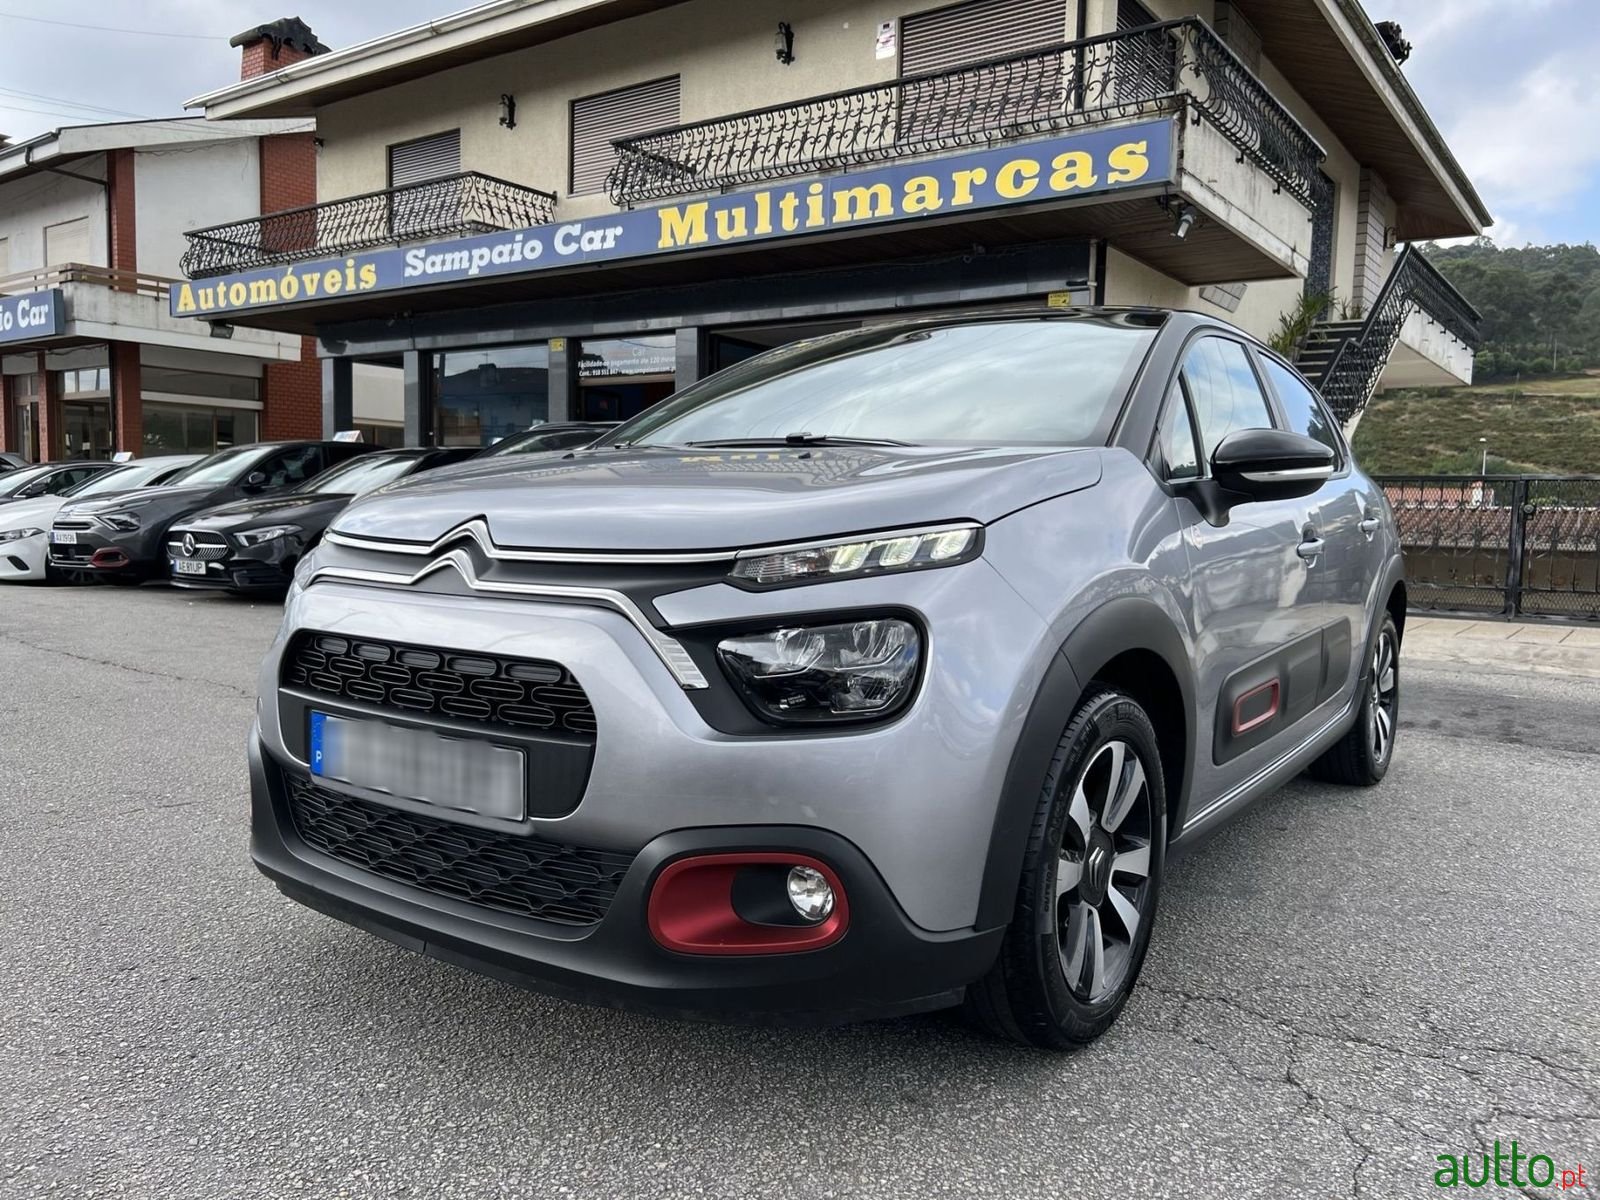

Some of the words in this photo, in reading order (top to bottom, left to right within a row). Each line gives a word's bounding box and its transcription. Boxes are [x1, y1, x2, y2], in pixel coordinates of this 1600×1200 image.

[176, 258, 378, 313] Automóveis
[404, 234, 543, 278] Sampaio
[554, 223, 624, 256] Car
[657, 140, 1150, 249] Multimarcas
[17, 298, 49, 328] Car
[315, 749, 323, 763] P
